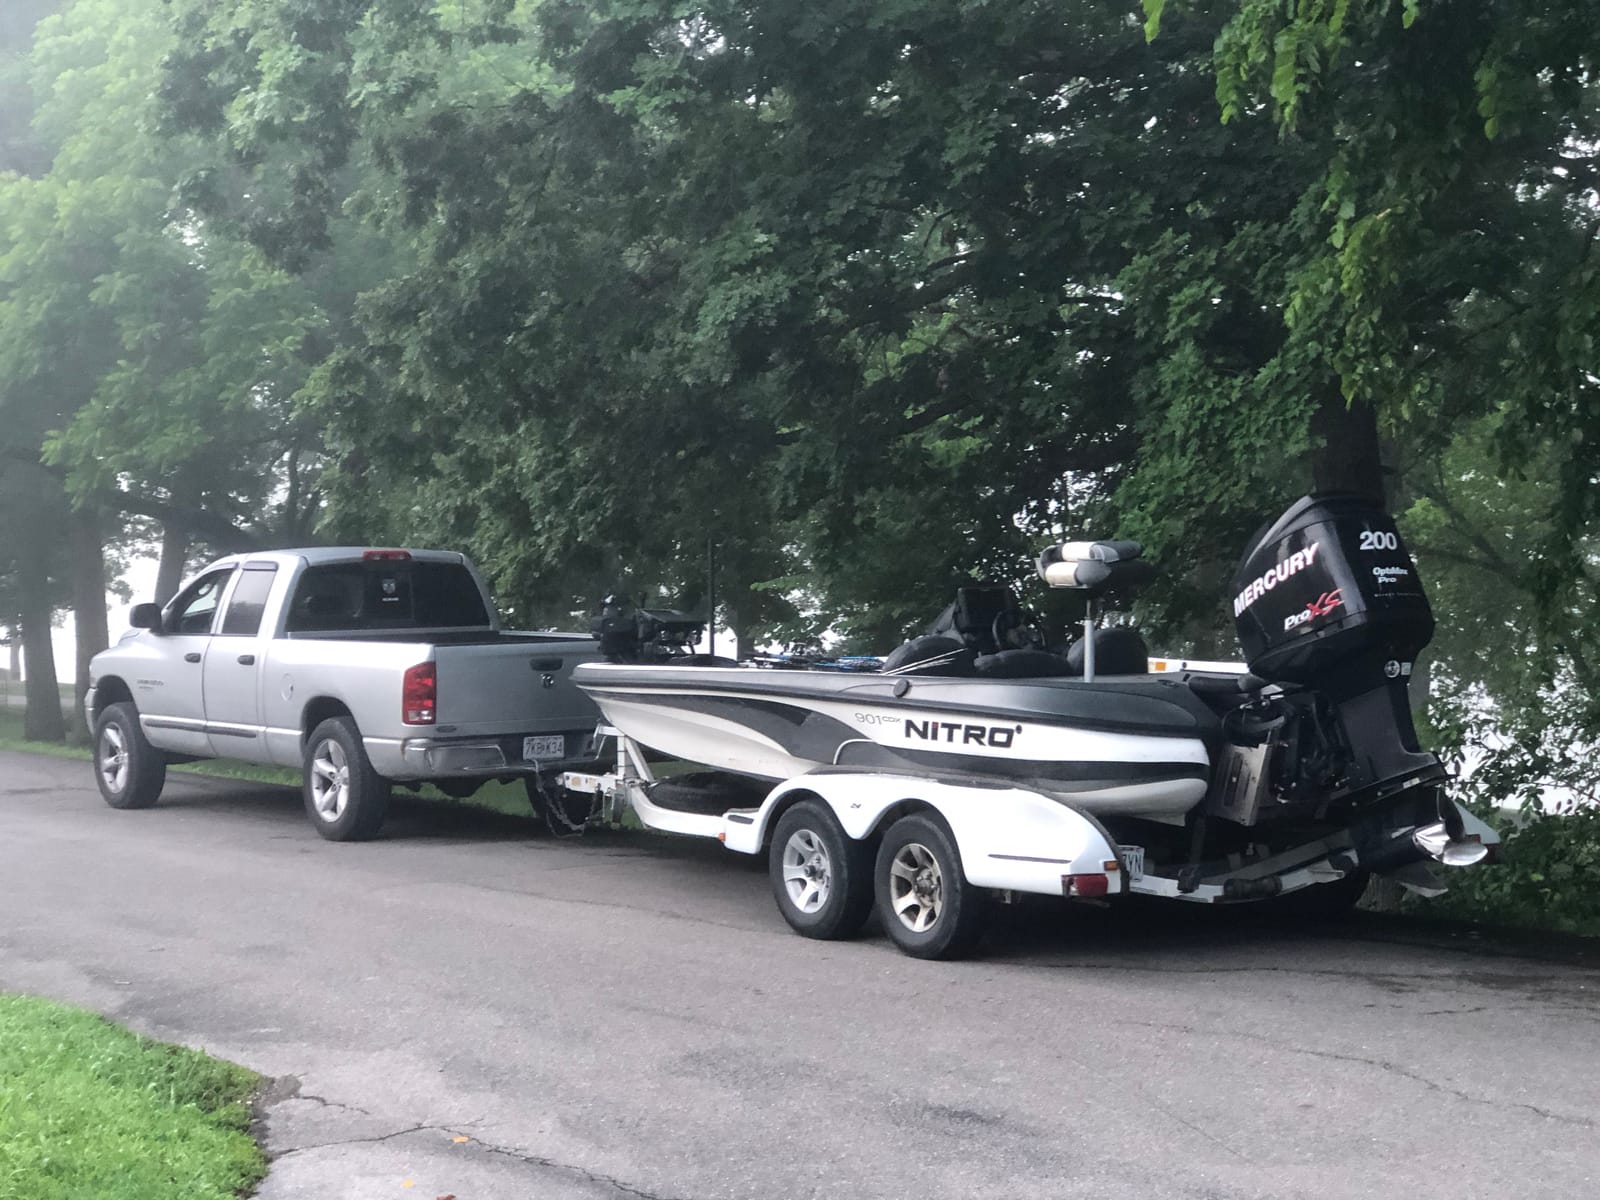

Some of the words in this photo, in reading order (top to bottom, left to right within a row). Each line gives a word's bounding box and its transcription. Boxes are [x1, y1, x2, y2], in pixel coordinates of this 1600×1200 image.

[1360, 531, 1398, 550] 200
[1234, 542, 1319, 618] MERCURY
[905, 719, 1014, 748] NITRO
